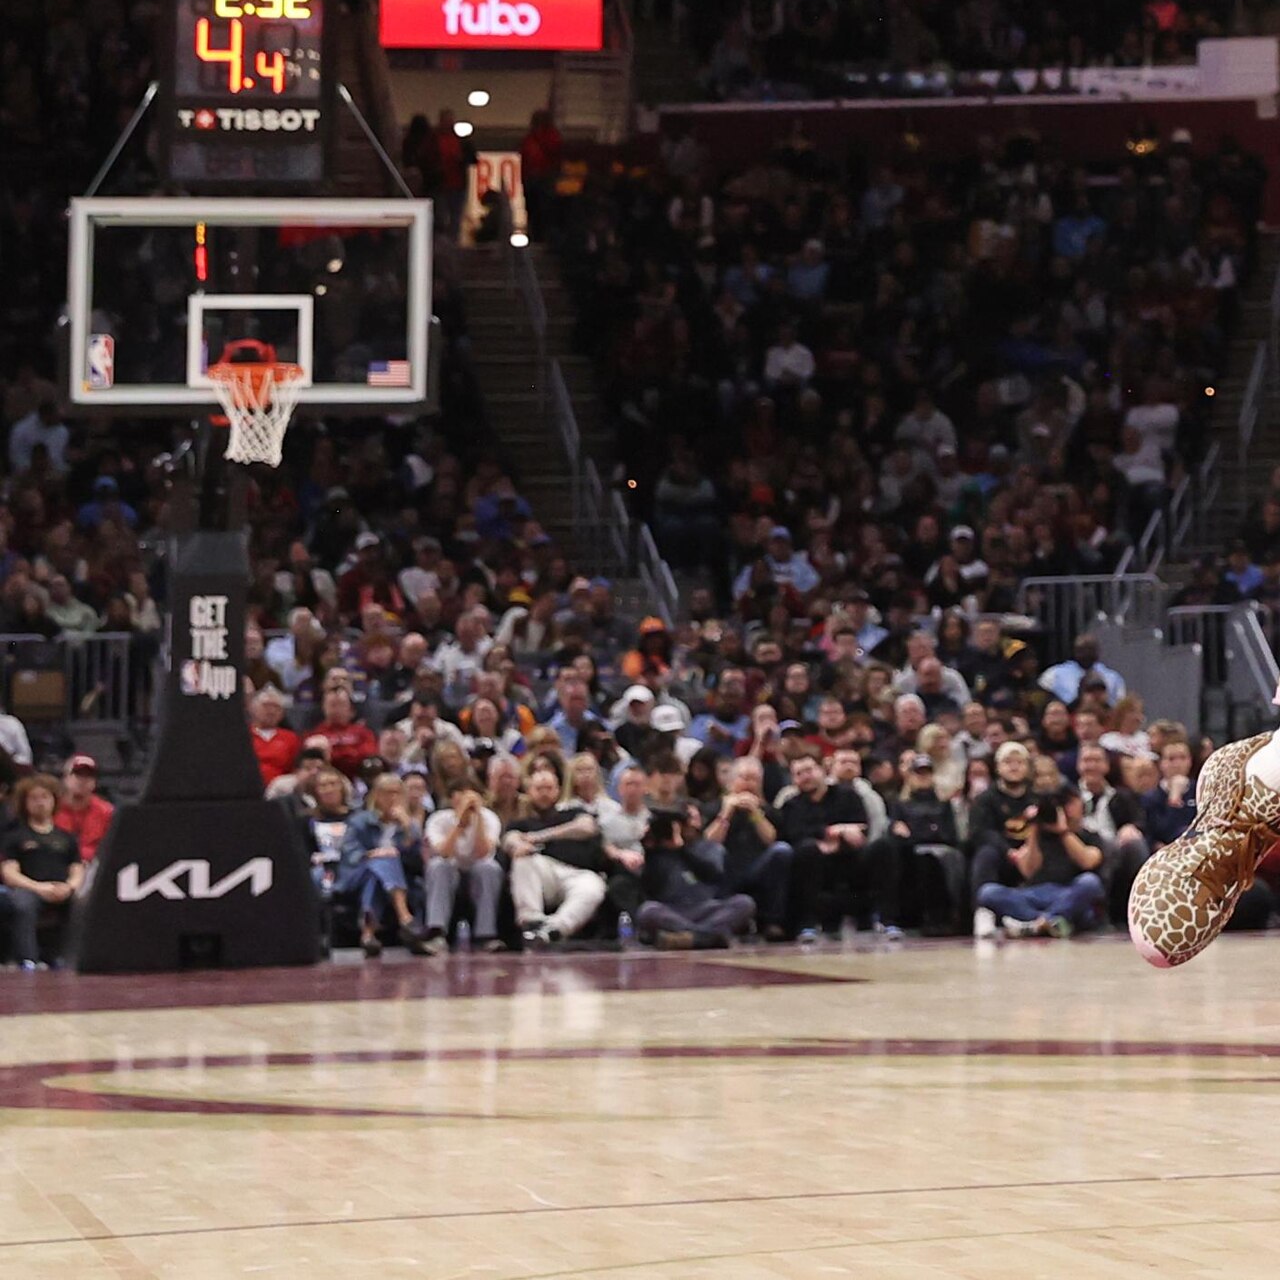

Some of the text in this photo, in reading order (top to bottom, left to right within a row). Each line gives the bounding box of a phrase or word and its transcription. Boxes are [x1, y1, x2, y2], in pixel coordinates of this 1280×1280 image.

[194, 17, 286, 95] 4.4
[216, 107, 321, 131] TISSOT
[190, 595, 228, 627] GET
[190, 628, 229, 660] THE
[117, 856, 273, 902] KIA
